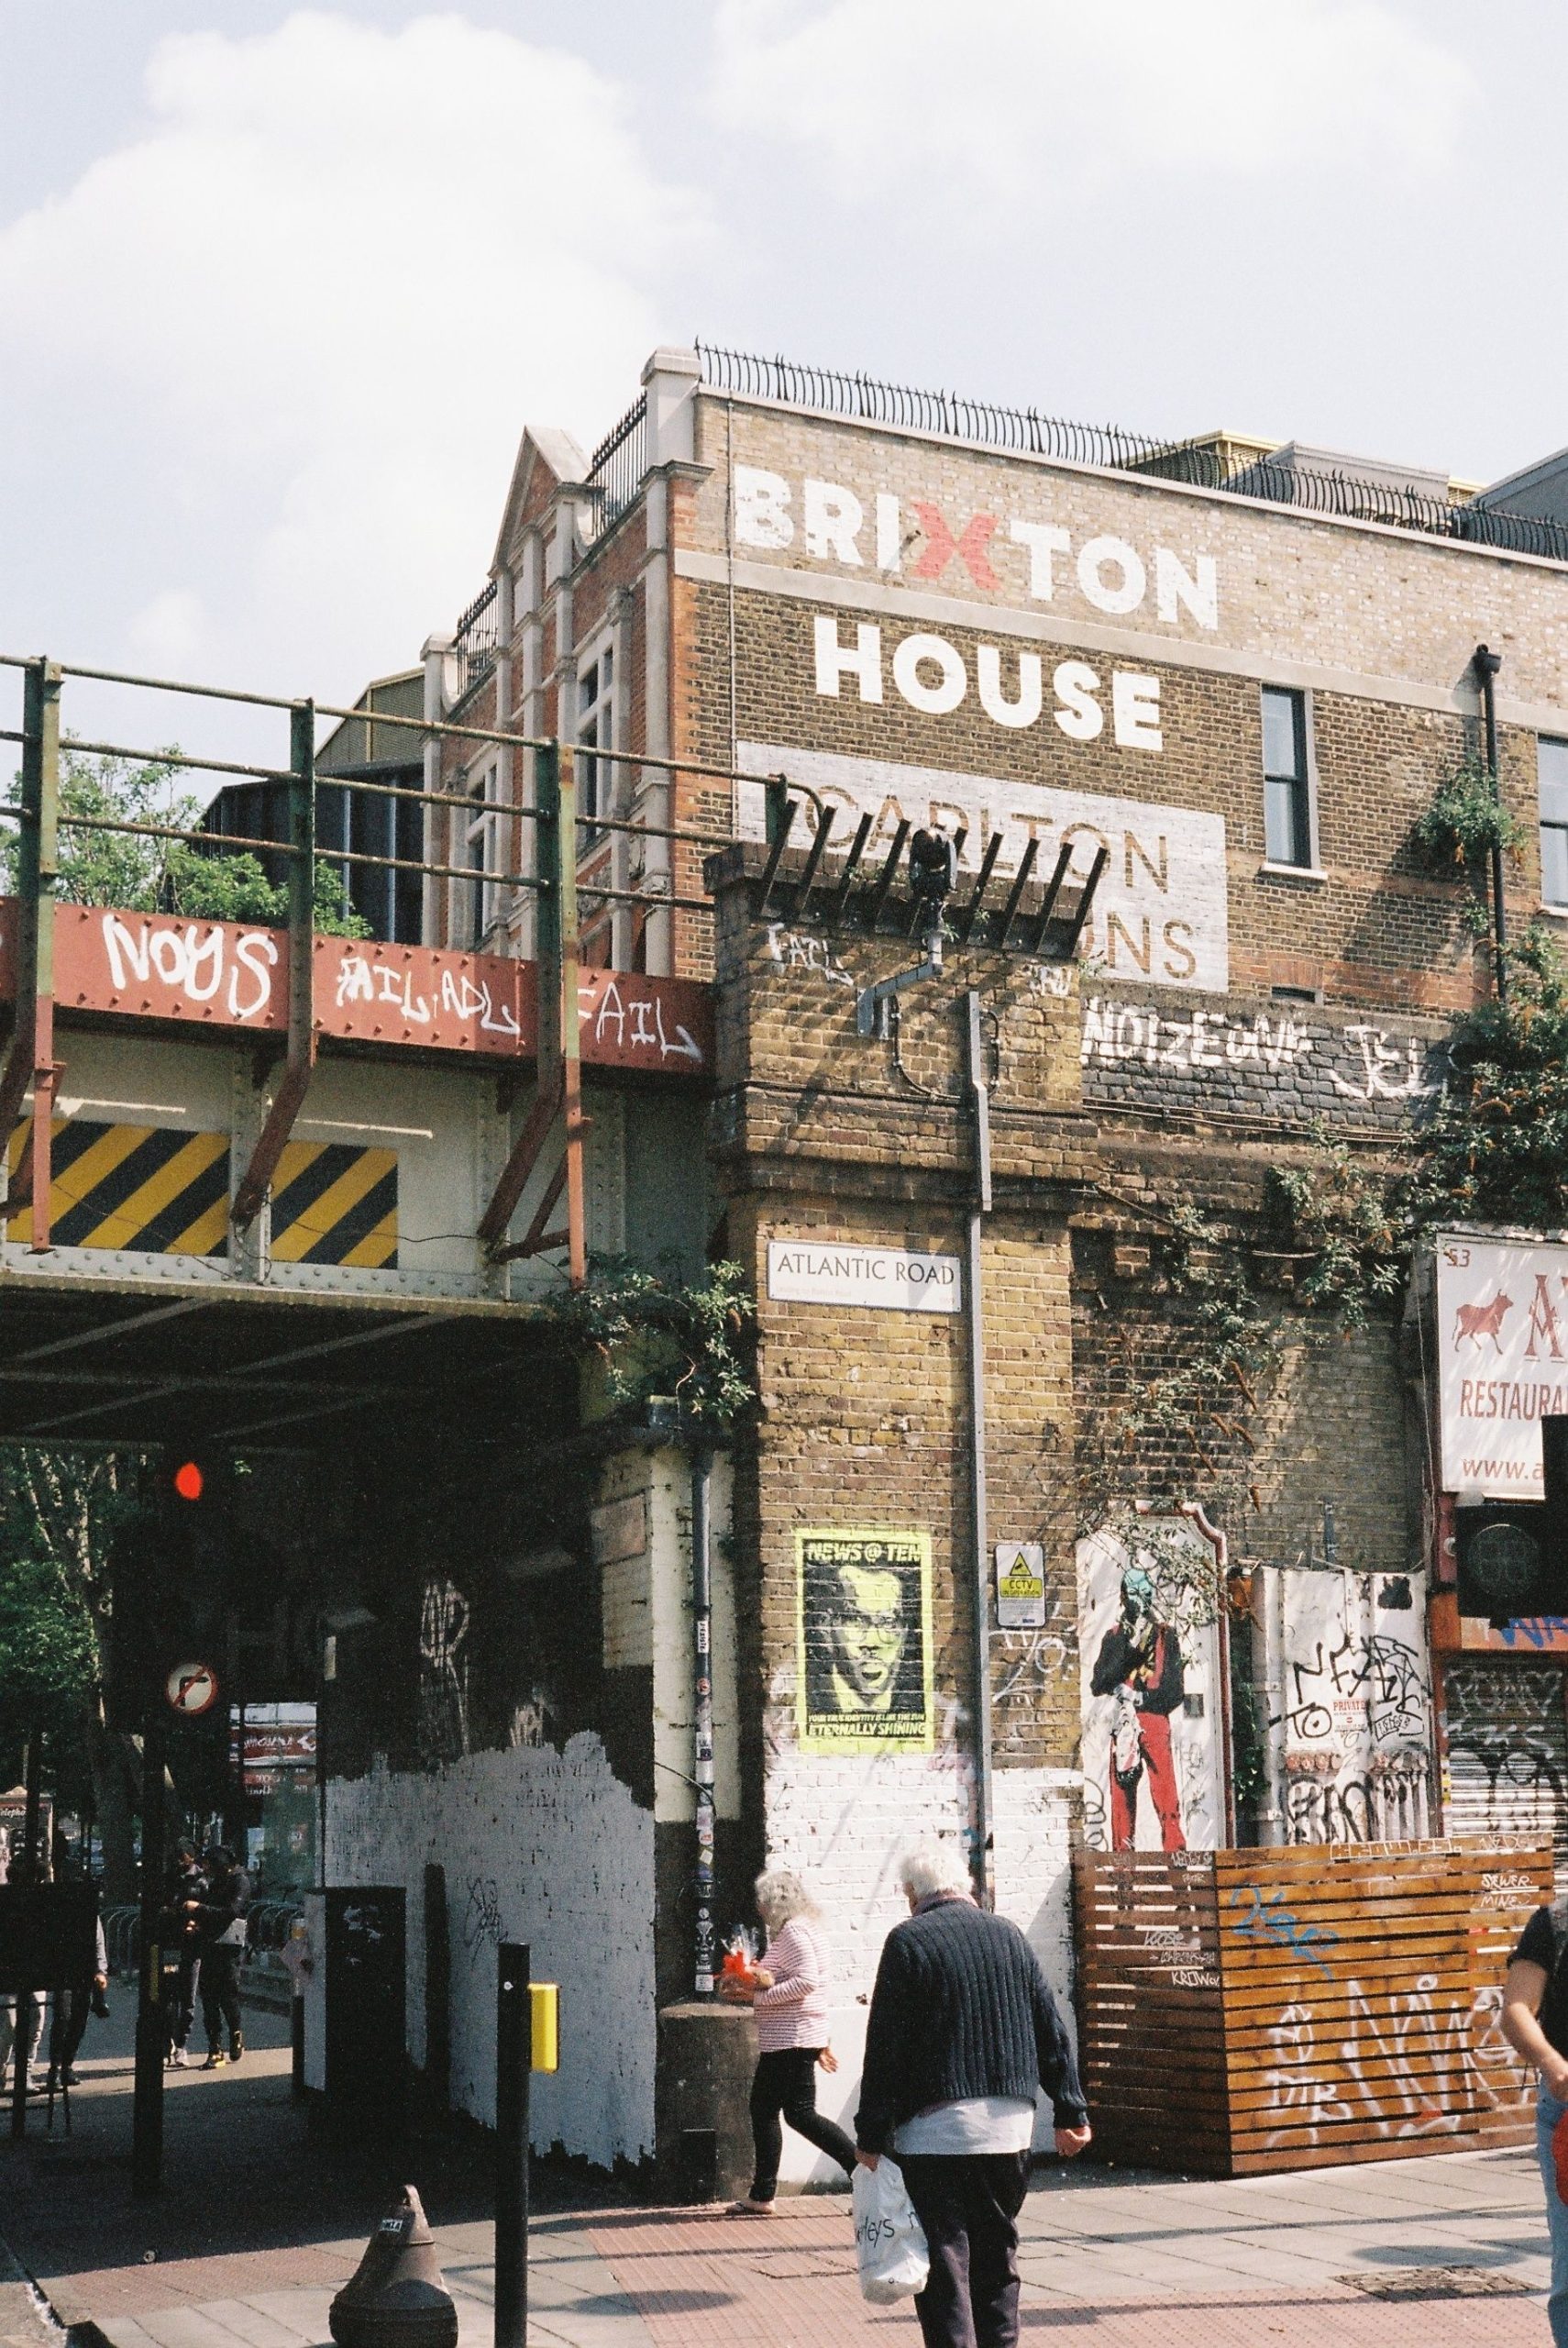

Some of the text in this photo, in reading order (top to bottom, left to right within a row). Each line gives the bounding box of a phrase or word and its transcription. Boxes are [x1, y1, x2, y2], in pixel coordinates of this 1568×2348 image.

[734, 466, 1218, 630] BRIXTON
[813, 615, 1163, 751] HOUSE
[805, 785, 1169, 894] CARLTON
[778, 1253, 955, 1284] ATLANTIC ROAD
[1461, 1379, 1568, 1421] RESTAURA
[1463, 1459, 1543, 1479] www.a
[807, 1542, 862, 1561] NEWS
[887, 1544, 922, 1562] TEN
[1009, 1579, 1033, 1589] CCTV
[1332, 1700, 1366, 1711] PRIVATE
[808, 1722, 926, 1735] ETERNALLY SHINING
